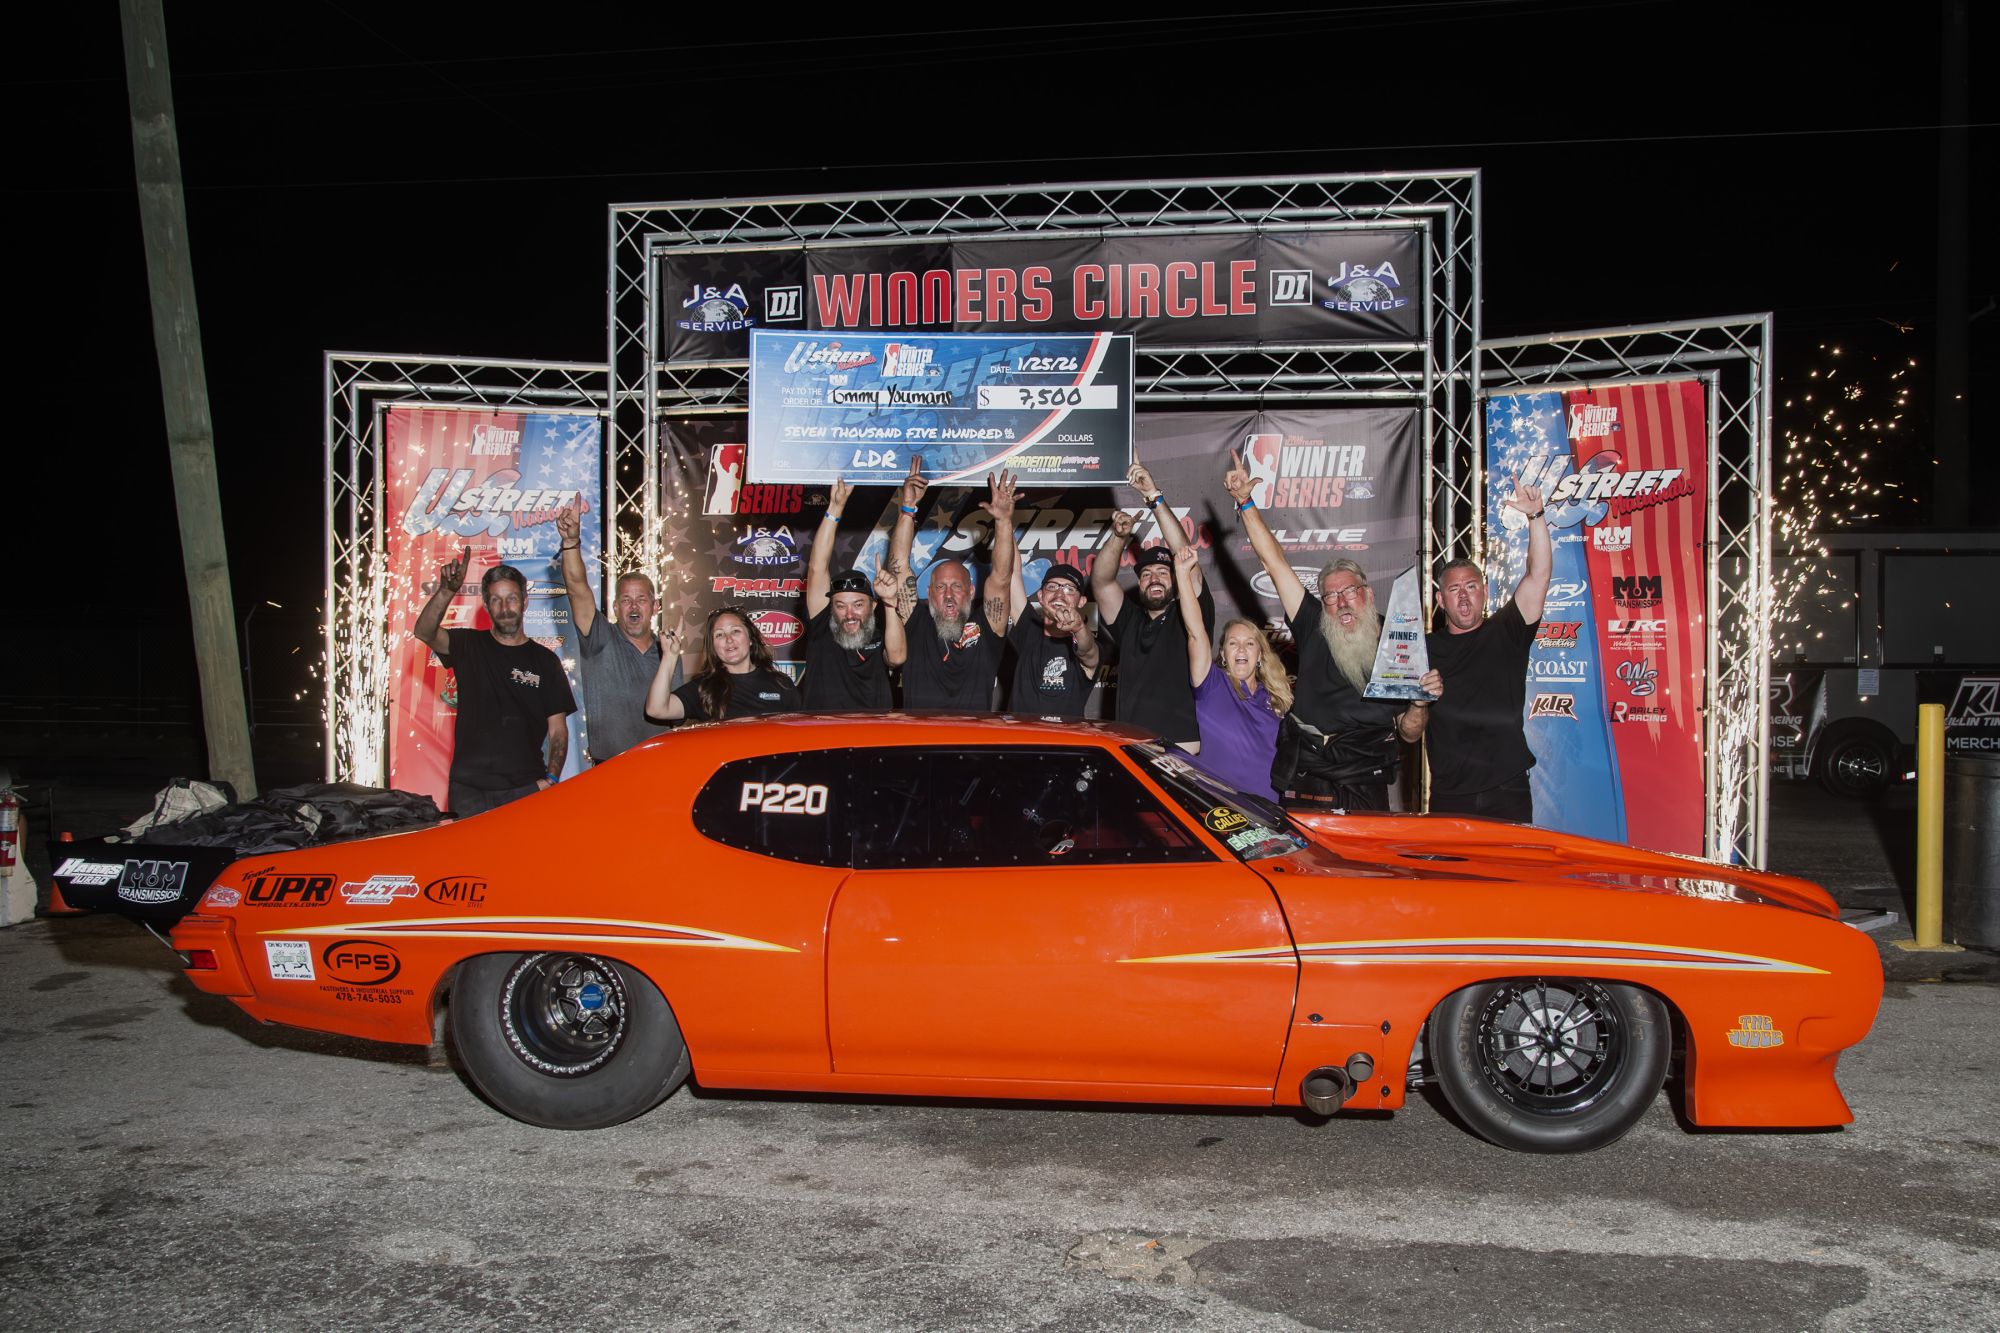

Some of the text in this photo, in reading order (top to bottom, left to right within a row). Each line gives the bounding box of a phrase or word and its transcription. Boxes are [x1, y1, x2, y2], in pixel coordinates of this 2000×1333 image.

[1328, 261, 1400, 287] J&A
[683, 283, 749, 308] J&A
[813, 260, 1256, 327] WINNERS CIRCLE
[1324, 299, 1405, 312] SERVICE
[680, 319, 754, 332] SERVICE
[899, 347, 933, 363] WINTER
[896, 362, 925, 377] SERIES
[990, 365, 1012, 374] DATE:
[1017, 356, 1078, 371] 1/25/26
[781, 387, 796, 395] PAY
[979, 388, 990, 407] $
[1019, 387, 1082, 410] 7,500
[783, 397, 809, 406] ORDER
[831, 386, 879, 417] Tommy
[1584, 407, 1618, 422] WINTER
[486, 430, 519, 443] WINTER
[784, 426, 826, 438] SEVEN
[831, 427, 902, 439] THOUSAND
[906, 427, 937, 439] FIVE
[941, 428, 1002, 440] HUNDRED
[1583, 422, 1610, 437] SERIES
[1058, 434, 1093, 442] DOLLARS
[484, 442, 511, 455] SERIES
[852, 449, 897, 469] LDR
[1005, 455, 1062, 468] BRADENTON
[1280, 446, 1366, 477] WINTER
[1553, 468, 1684, 499] STREET
[740, 485, 804, 514] SERIES
[1275, 477, 1345, 507] SERIES
[456, 489, 580, 512] STREET
[737, 525, 795, 544] J&A
[1270, 529, 1367, 543] LITE
[734, 555, 800, 565] SERVICE
[1613, 600, 1662, 608] TRANSMISSION
[775, 622, 799, 634] LINE
[1389, 631, 1417, 641] WINNER
[1535, 660, 1587, 676] COAST
[1628, 714, 1668, 722] RACING
[739, 781, 829, 816] P220
[1213, 812, 1247, 830] CALLIES
[1226, 826, 1273, 851] ENERGY
[53, 858, 124, 878] HARTS
[241, 866, 275, 881] Team
[70, 875, 111, 886] TURBO
[119, 886, 180, 902] TRANSMISSION
[249, 877, 333, 902] UPR
[336, 953, 391, 971] FPS
[320, 985, 349, 993] FASTENERS
[355, 987, 388, 995] INDUSTRIAL
[336, 992, 402, 1004] 478-745-5033
[1478, 988, 1505, 1044] RACING
[1739, 1014, 1773, 1030] THE
[1727, 1029, 1784, 1048] JUDGE
[1484, 1065, 1514, 1103] WELD
